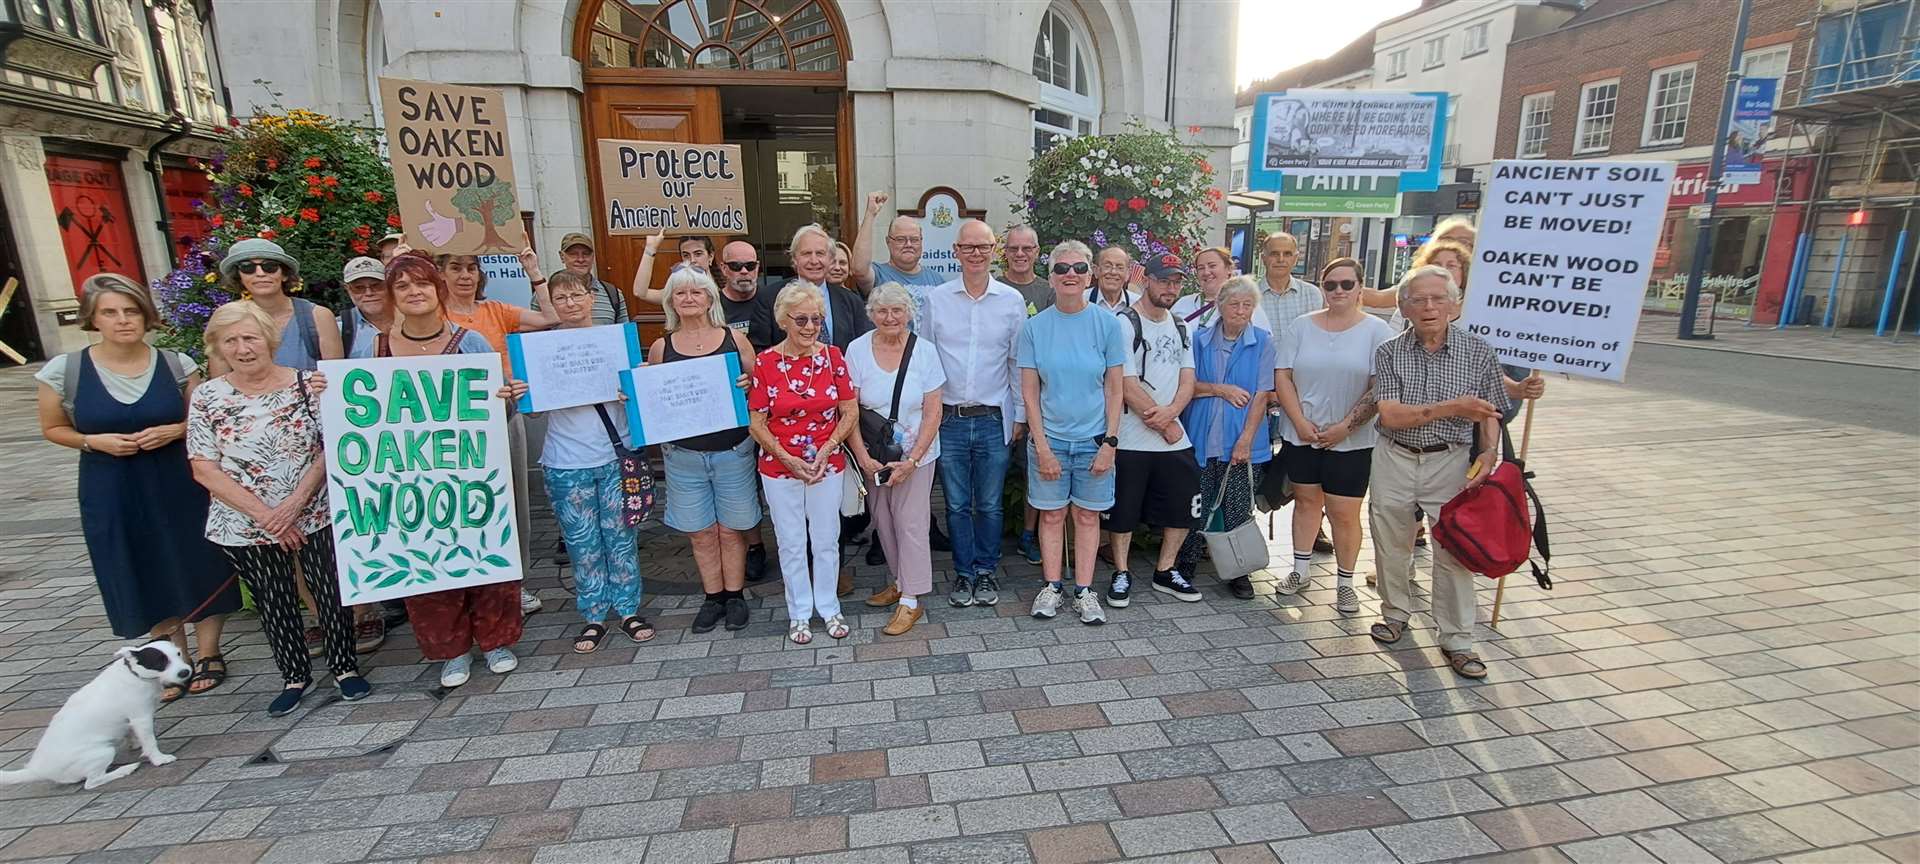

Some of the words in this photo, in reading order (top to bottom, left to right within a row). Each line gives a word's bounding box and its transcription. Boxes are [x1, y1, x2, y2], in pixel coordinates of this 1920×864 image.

[398, 86, 492, 126] SAVE
[1311, 111, 1345, 123] WHERE
[1411, 112, 1425, 124] WE
[398, 126, 505, 158] OAKEN
[1309, 124, 1340, 136] DON'T
[1368, 124, 1396, 136] MORE
[618, 146, 735, 179] Protect
[1495, 165, 1601, 181] ANCIENT
[1607, 167, 1664, 182] SOIL
[84, 171, 112, 185] OUT
[407, 161, 496, 190] WOOD
[662, 180, 695, 198] our
[1504, 190, 1573, 206] CAN'T
[1579, 193, 1645, 208] JUST
[610, 200, 680, 230] Ancient
[683, 203, 744, 231] Woods
[1374, 201, 1390, 209] Party
[1503, 215, 1533, 229] BE
[1540, 217, 1633, 234] MOVED!
[501, 268, 526, 278] Hall
[948, 263, 963, 273] Ha
[1482, 250, 1559, 268] OAKEN
[1566, 255, 1639, 274] WOOD
[1498, 271, 1565, 289] CAN'T
[1571, 276, 1603, 292] BE
[1487, 294, 1611, 319] IMPROVED!
[1468, 323, 1491, 336] NO
[1496, 327, 1511, 339] to
[1516, 330, 1596, 350] extension
[1601, 340, 1621, 352] of
[1495, 346, 1548, 363] mitage
[1553, 353, 1612, 373] Quarry
[342, 368, 490, 428] SAVE
[337, 429, 488, 476] OAKEN
[344, 479, 496, 537] WOOD
